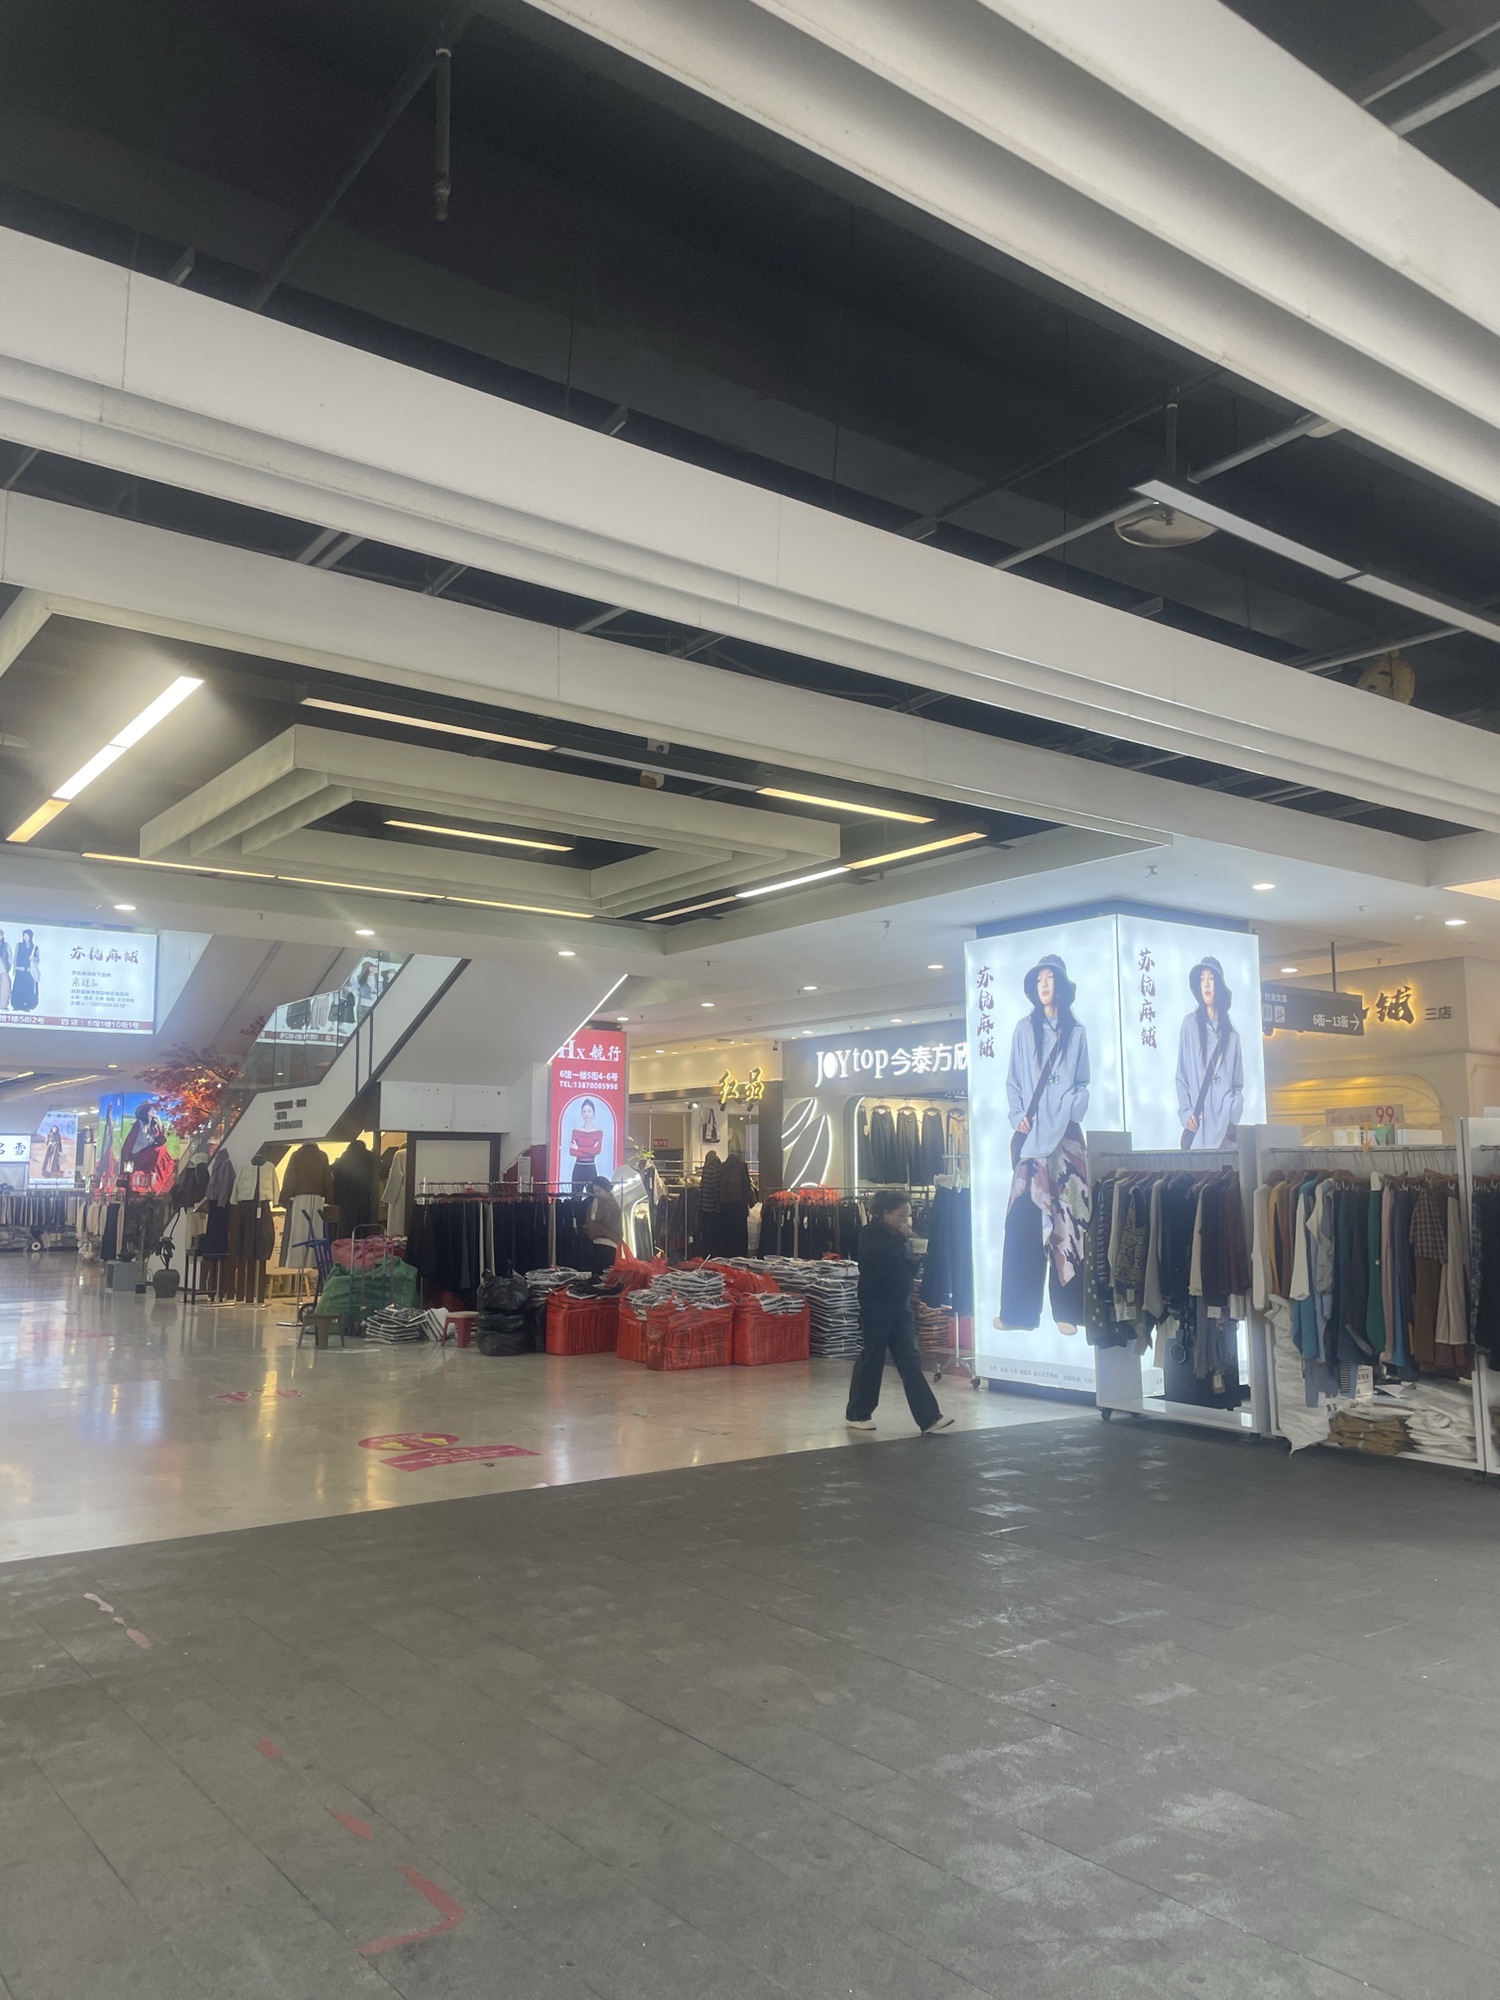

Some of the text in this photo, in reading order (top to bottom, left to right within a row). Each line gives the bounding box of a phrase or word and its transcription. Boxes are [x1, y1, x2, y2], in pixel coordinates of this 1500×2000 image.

[1138, 947, 1157, 1049] 苏杭麻铺
[976, 965, 995, 1059] 苏杭麻铺
[1425, 1006, 1452, 1021] 三店
[589, 1044, 621, 1062] 航行
[1375, 1105, 1395, 1124] 99
